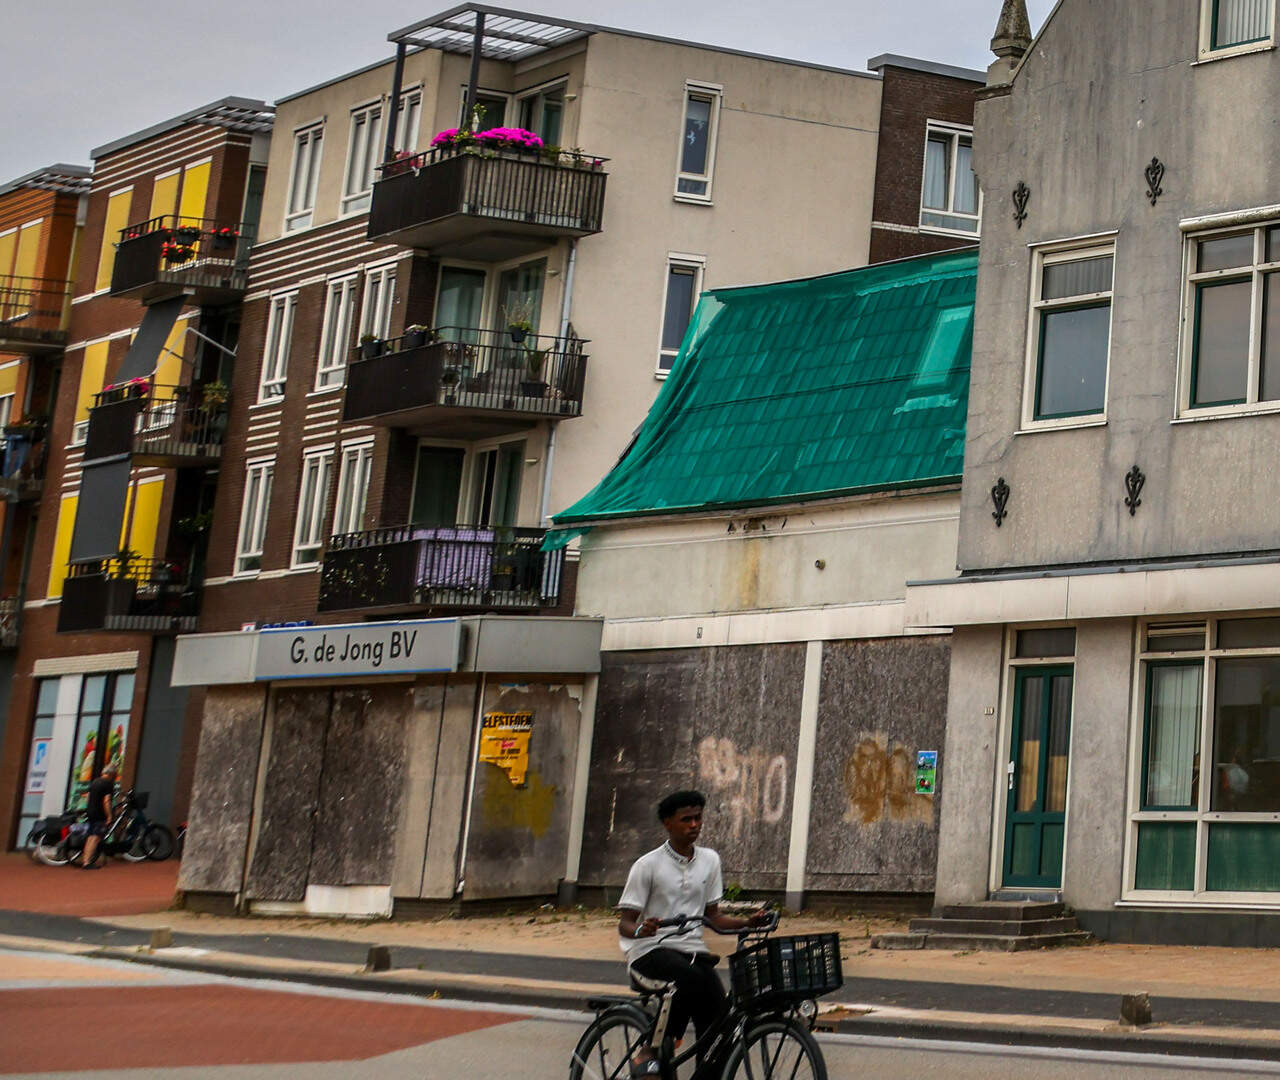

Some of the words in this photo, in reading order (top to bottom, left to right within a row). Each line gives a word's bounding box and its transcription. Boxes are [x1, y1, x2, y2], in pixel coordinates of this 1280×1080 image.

[290, 635, 309, 664] G.
[314, 634, 336, 662] de
[340, 633, 385, 667] Jong
[390, 630, 418, 659] BV
